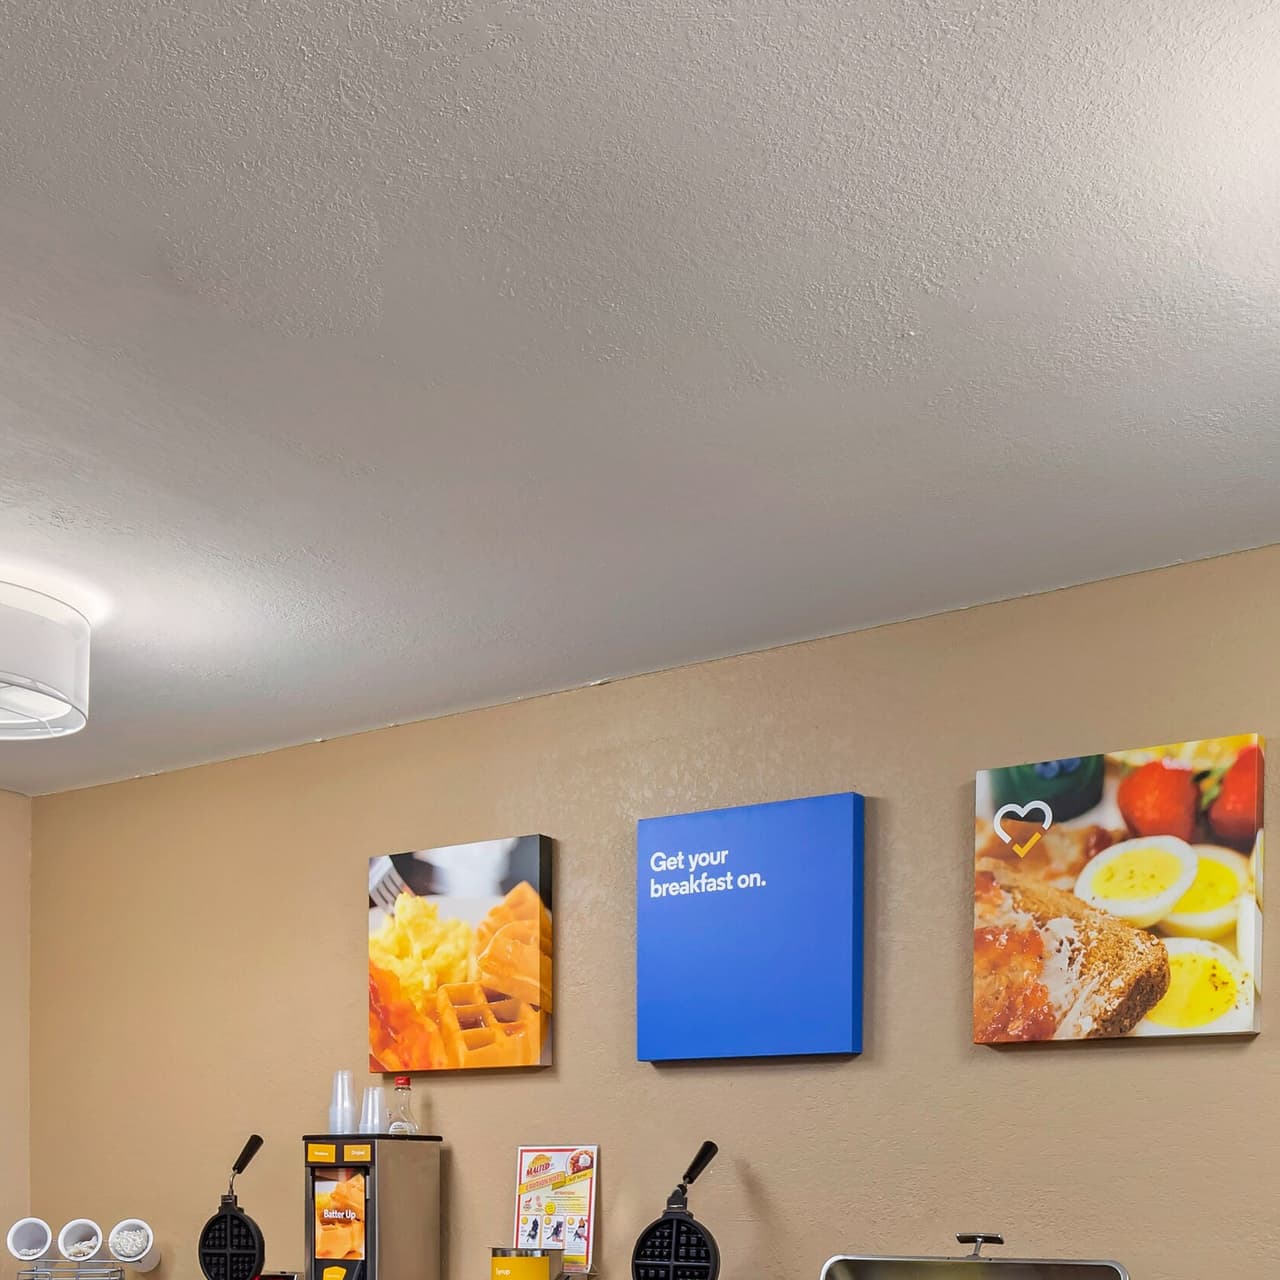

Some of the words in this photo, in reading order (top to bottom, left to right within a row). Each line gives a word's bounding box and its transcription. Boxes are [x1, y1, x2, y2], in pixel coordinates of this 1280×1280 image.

[650, 851, 685, 872] Get
[688, 850, 729, 873] your
[649, 871, 734, 898] breakfast
[737, 872, 767, 889] on.
[323, 1208, 345, 1218] Batter
[345, 1208, 357, 1220] Up
